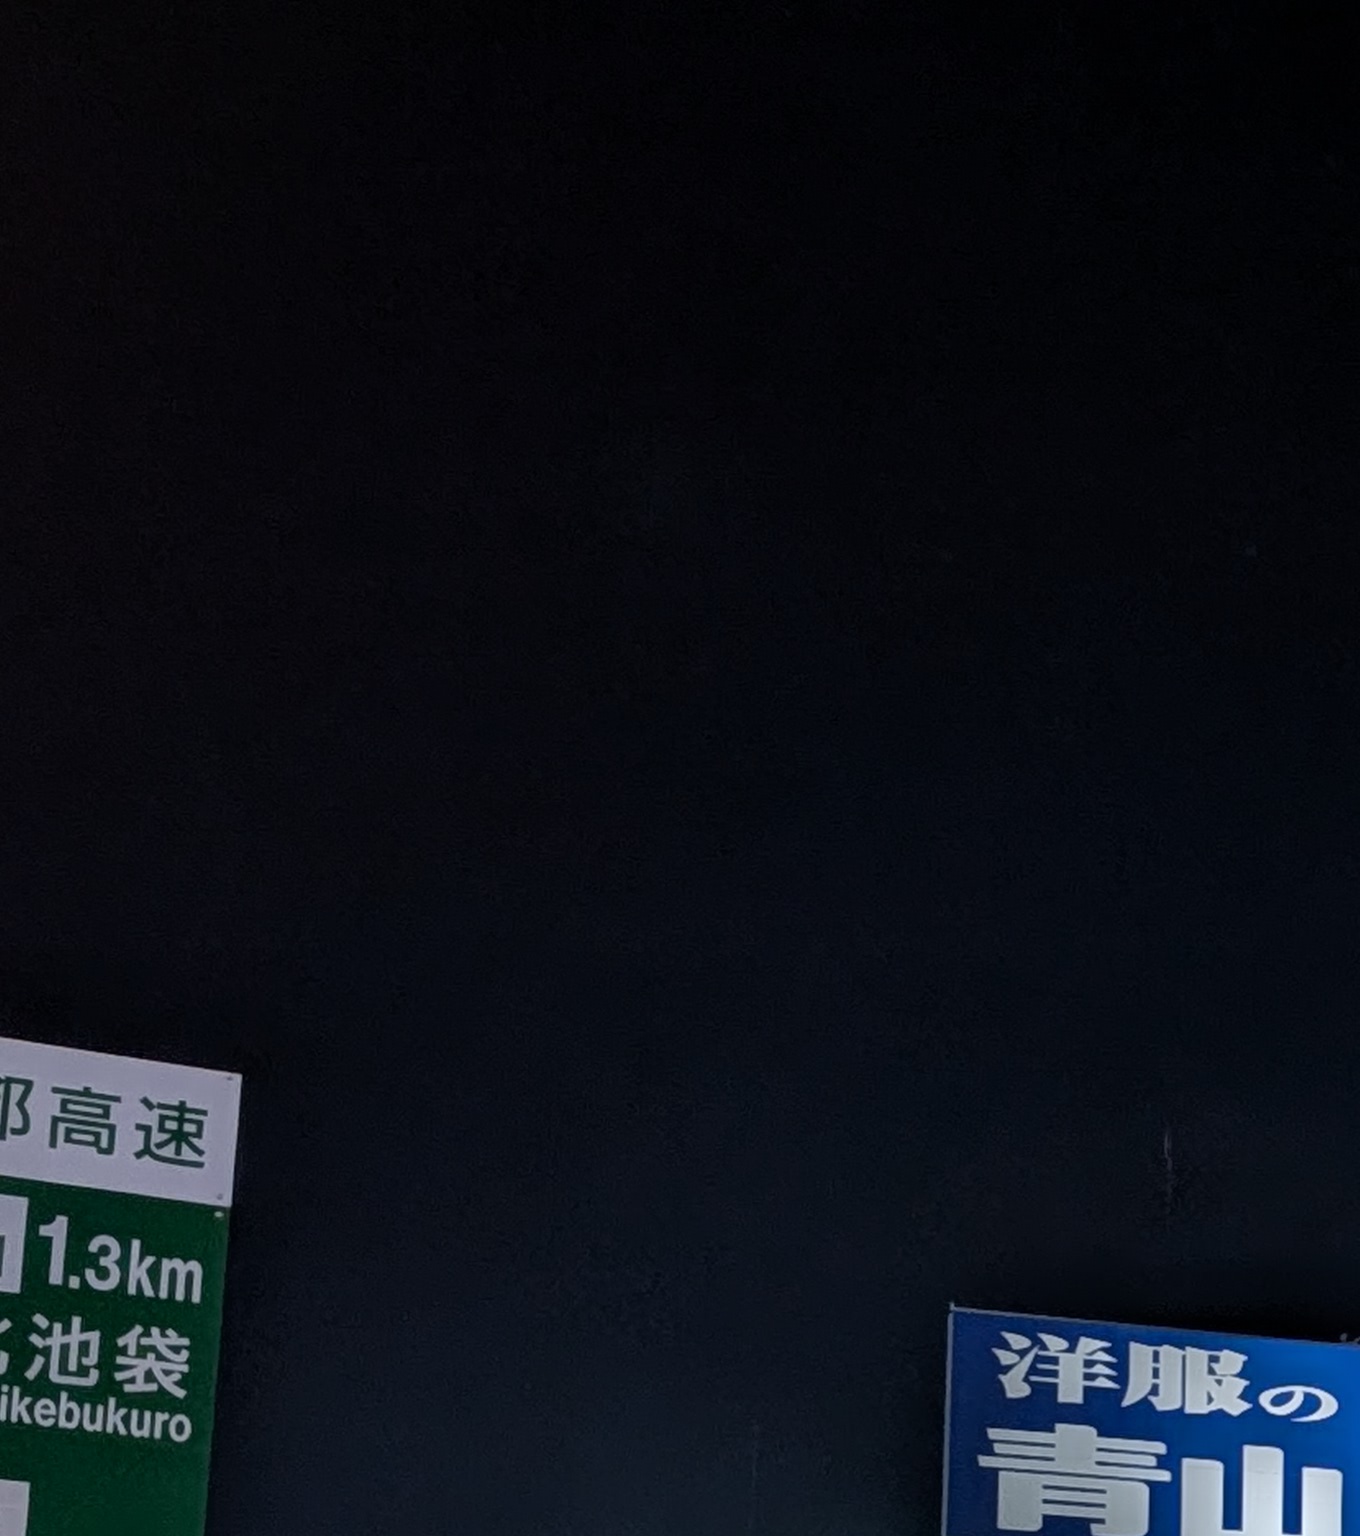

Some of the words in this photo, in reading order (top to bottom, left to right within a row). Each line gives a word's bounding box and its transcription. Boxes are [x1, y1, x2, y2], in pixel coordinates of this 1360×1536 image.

[38, 1214, 203, 1304] 1.3km
[0, 1313, 191, 1399] 池袋
[991, 1331, 1339, 1422] 洋服の
